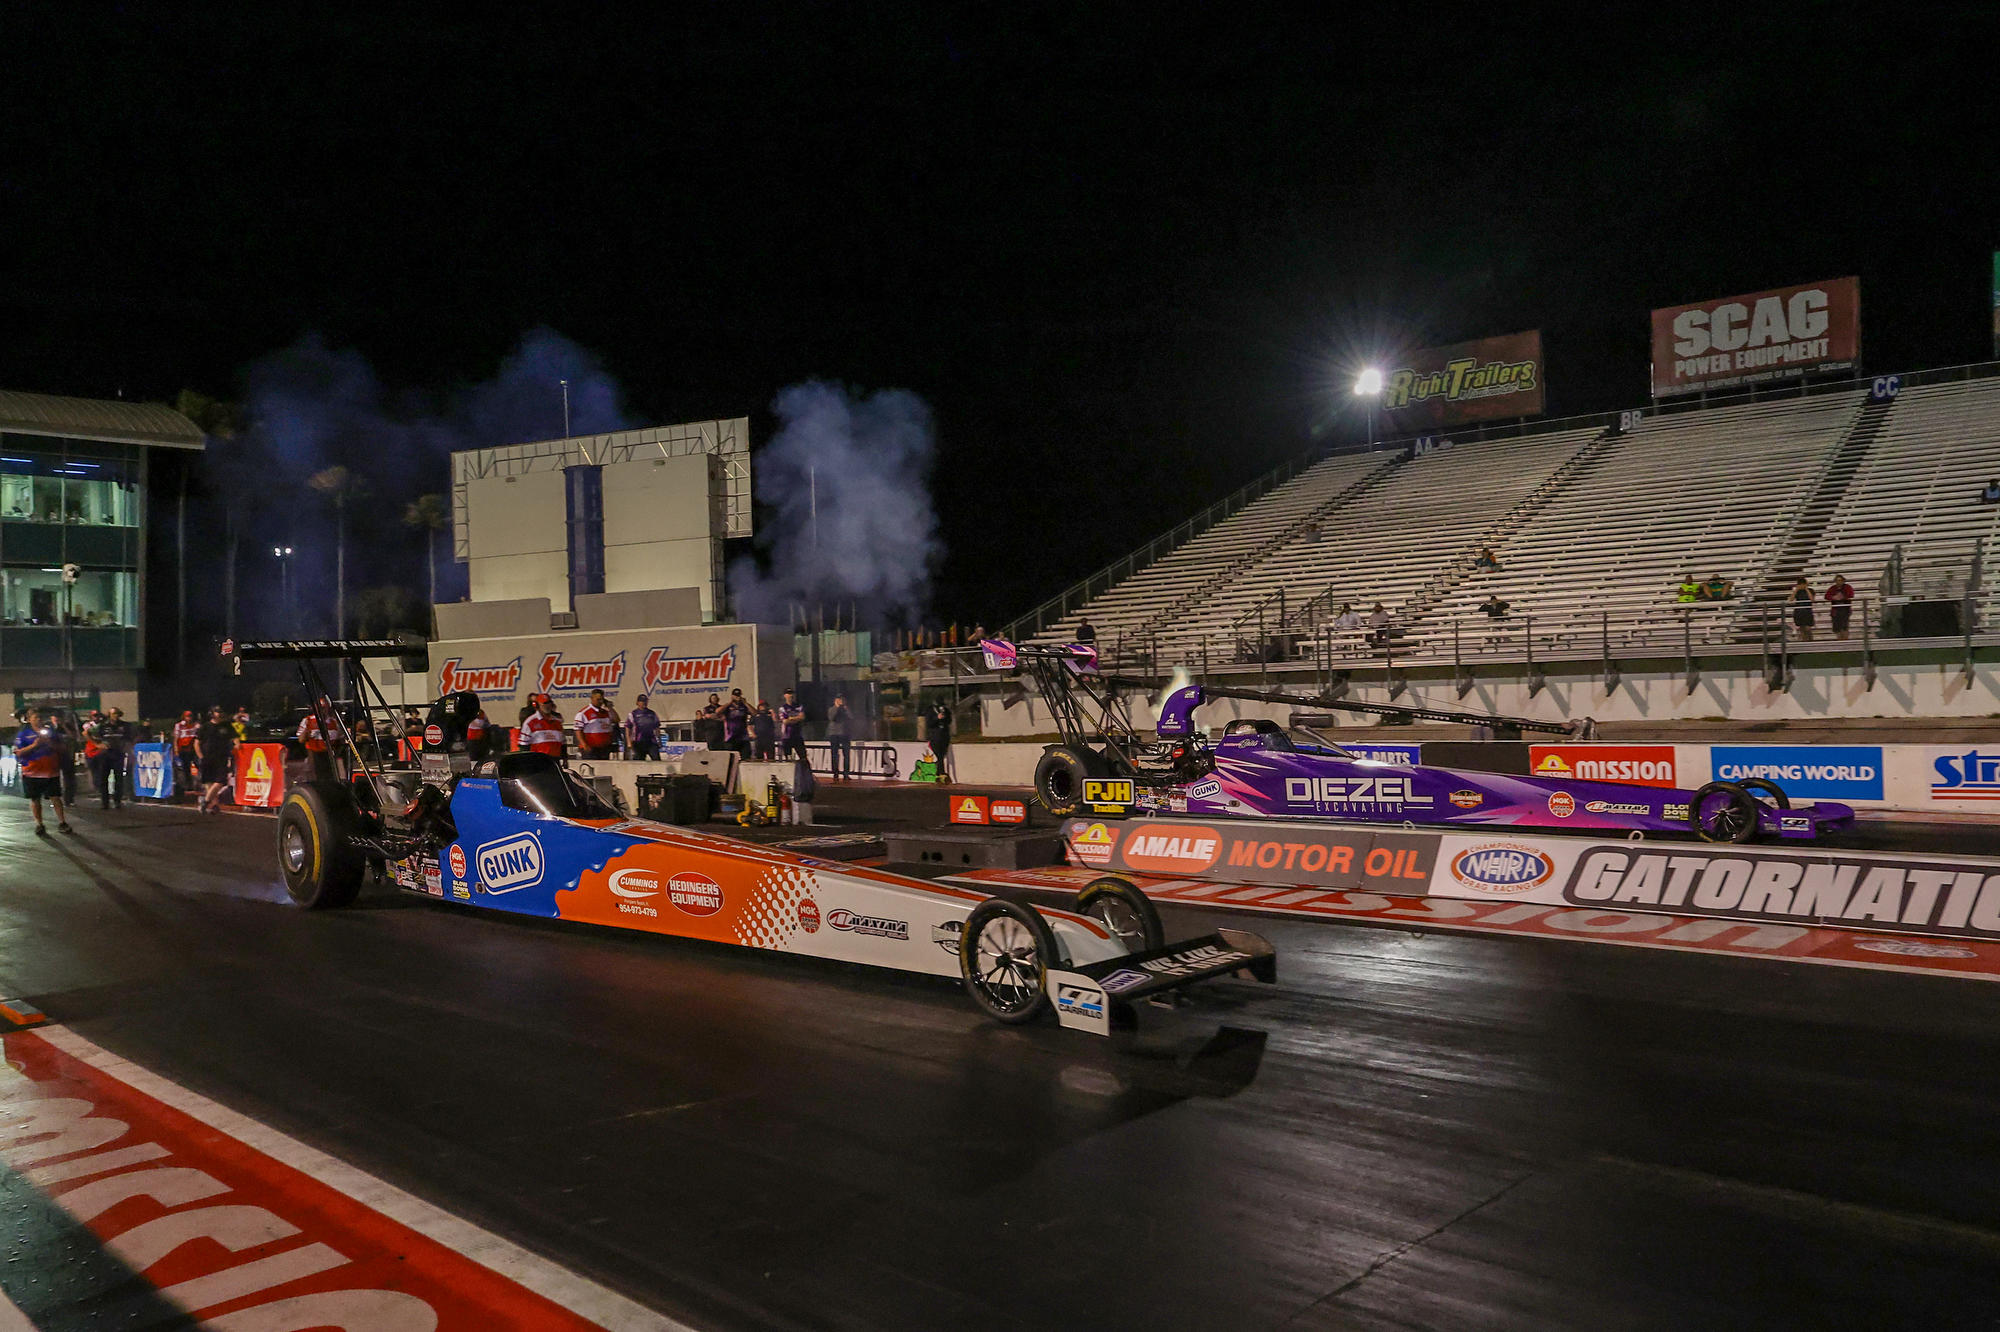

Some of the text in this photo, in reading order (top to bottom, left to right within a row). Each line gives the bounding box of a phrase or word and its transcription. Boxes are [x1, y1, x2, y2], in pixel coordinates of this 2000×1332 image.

[1673, 288, 1829, 358] SCAG
[1675, 338, 1830, 378] POWER EQUIPMENT
[1872, 376, 1898, 398] CC
[1621, 410, 1641, 431] BB
[1415, 437, 1432, 455] AA
[234, 656, 241, 676] 2
[1719, 764, 1875, 781] CAMPING WORLD
[1086, 782, 1131, 801] PJH
[1195, 783, 1218, 798] GUNK
[1286, 778, 1434, 804] DIEZEL
[1316, 801, 1403, 814] EXCAVATING
[1553, 796, 1569, 805] NGK
[1605, 803, 1649, 813] MAXIMA
[992, 805, 1024, 817] AMALIE
[1128, 836, 1217, 861] AMALIE
[1470, 843, 1540, 855] CHAMPIONSHIP
[484, 846, 536, 881] GUNK
[1226, 840, 1426, 880] MOTOR OIL
[1465, 851, 1539, 882] NHRA
[620, 877, 659, 890] CUMMINGS
[1463, 877, 1531, 893] DRAG RACING
[671, 893, 721, 909] EQUIPMENT
[619, 904, 658, 918] 954-973-4799
[800, 905, 817, 916] NGK
[849, 916, 908, 933] MAXIMA
[1059, 1004, 1103, 1021] CARRILLO
